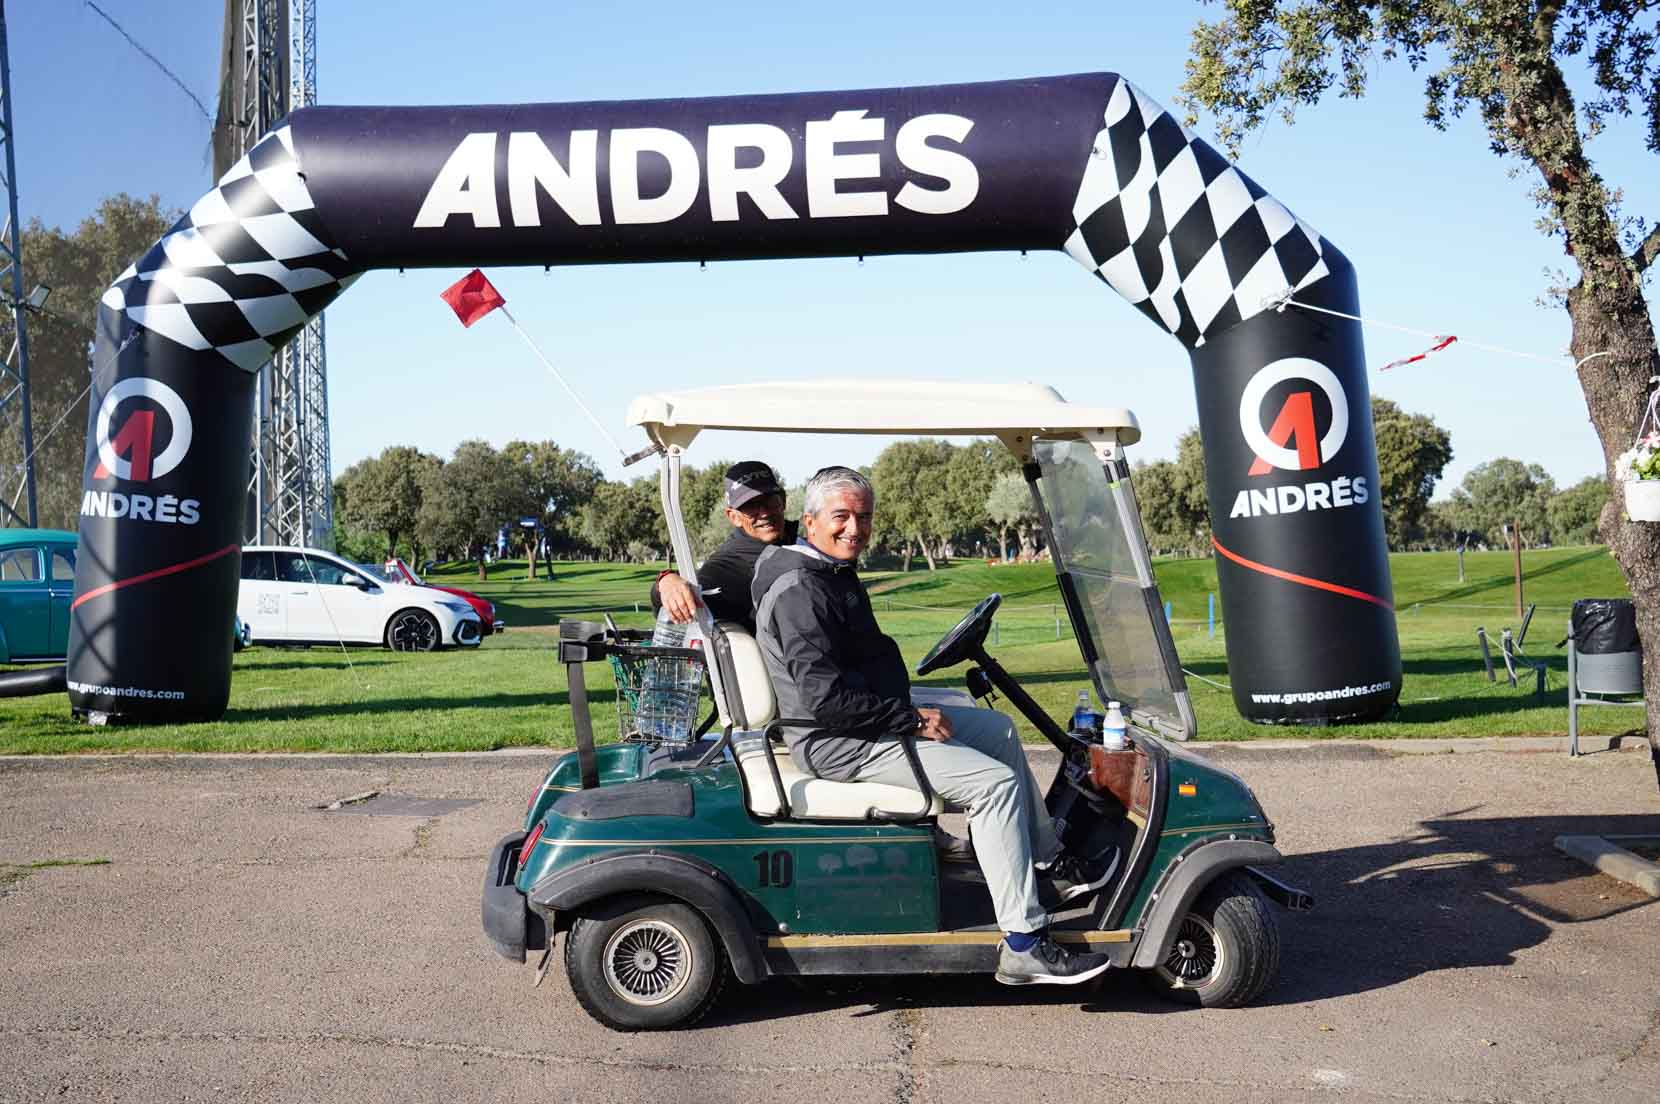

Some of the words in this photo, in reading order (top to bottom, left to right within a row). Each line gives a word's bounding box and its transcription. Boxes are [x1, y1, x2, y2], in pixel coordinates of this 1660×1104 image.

[413, 109, 980, 229] ANDRÉS
[81, 490, 201, 525] ANDRÉS
[1229, 476, 1369, 518] ANDRÉS
[1251, 681, 1391, 704] www.grupoandres.com
[753, 849, 793, 889] 10
